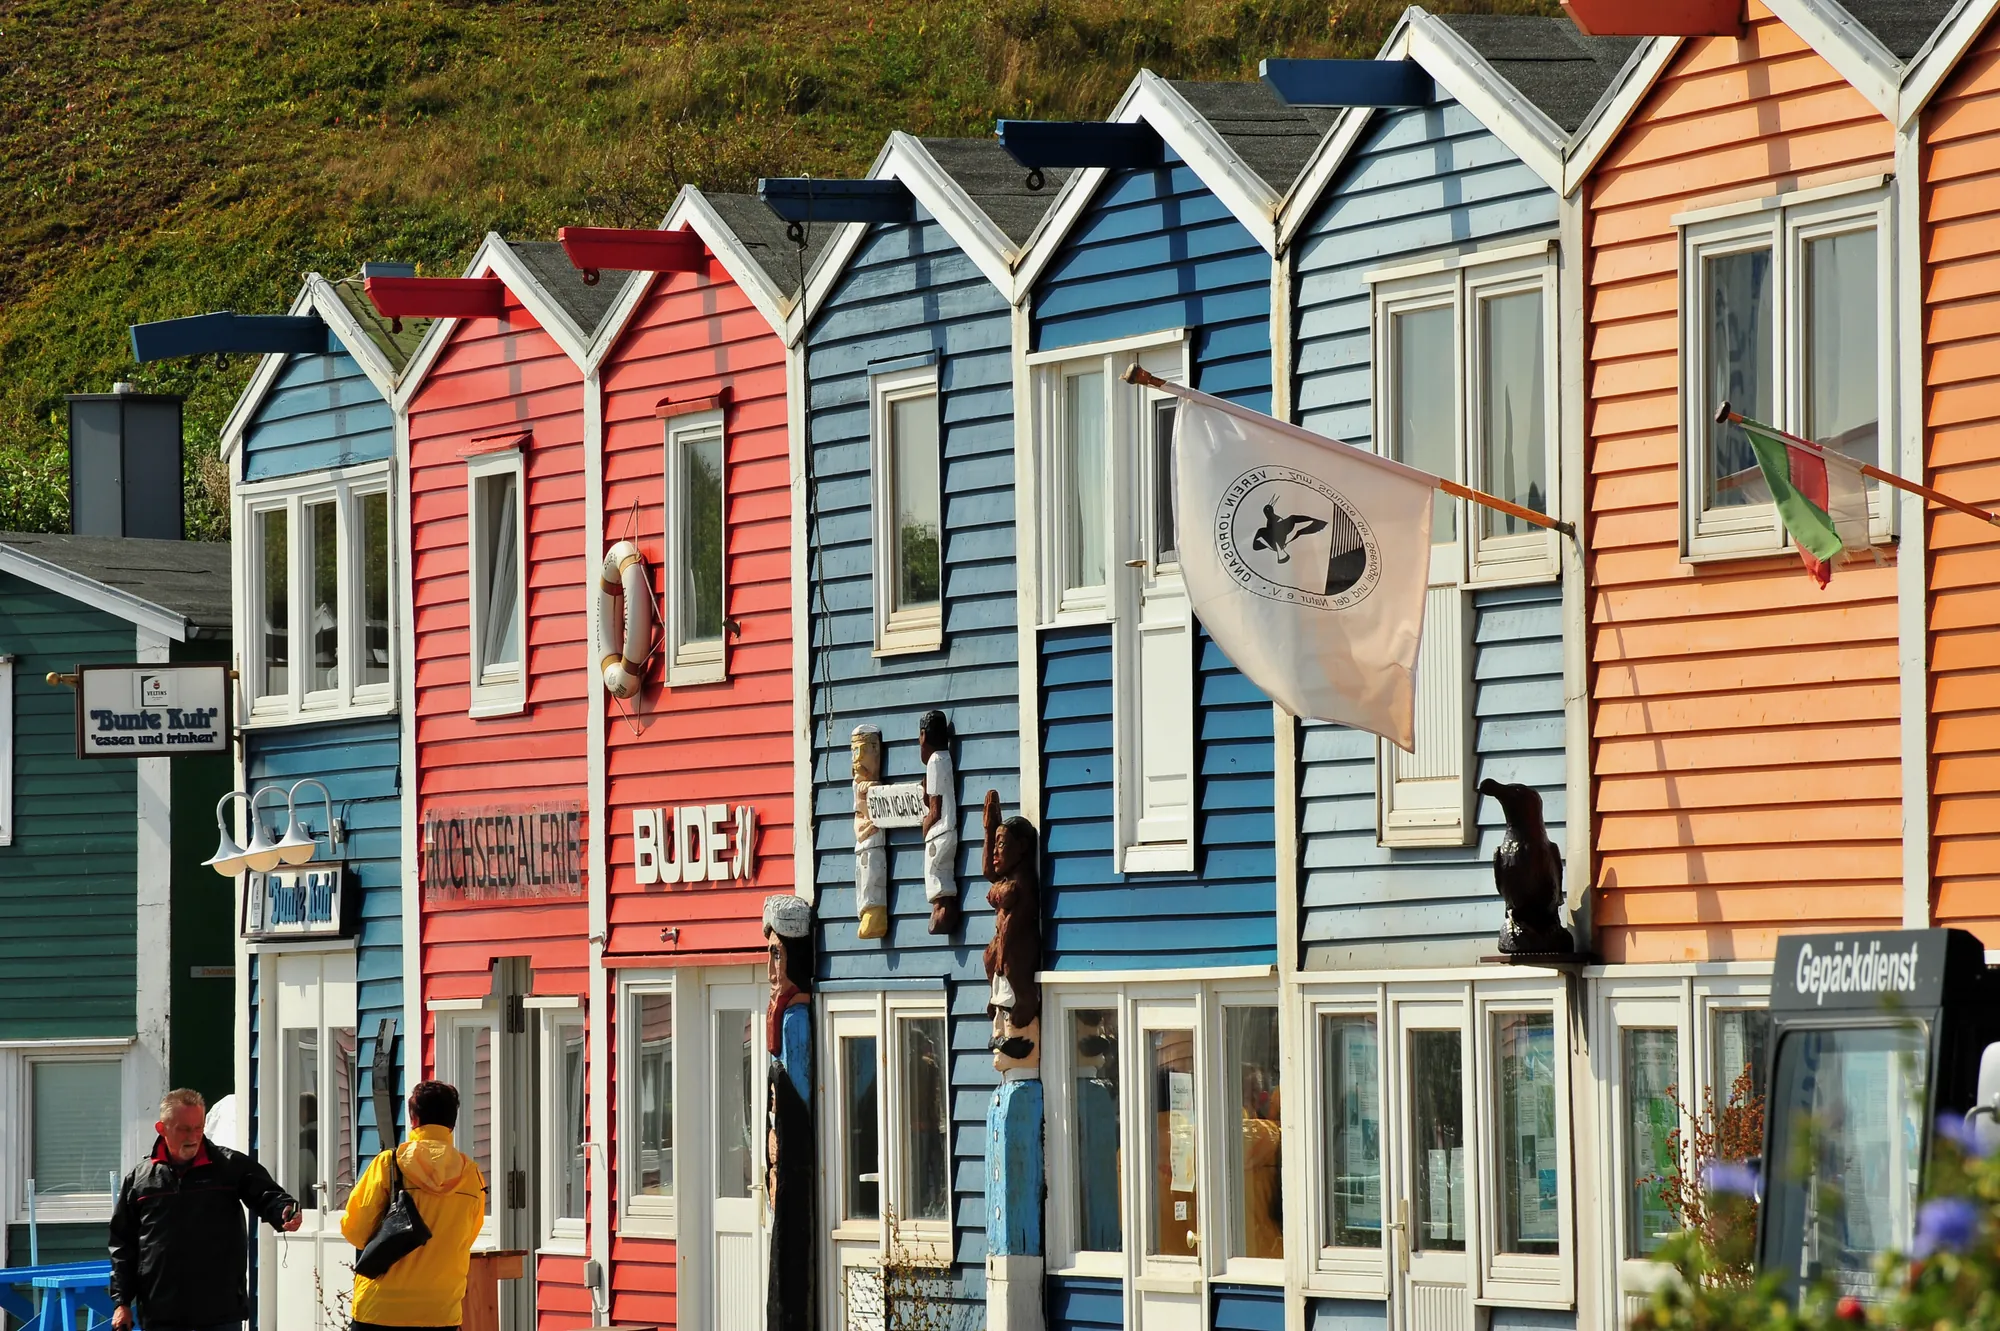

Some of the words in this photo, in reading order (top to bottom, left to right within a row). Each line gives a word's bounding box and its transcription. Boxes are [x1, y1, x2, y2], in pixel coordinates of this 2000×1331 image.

[91, 734, 135, 746] "essen
[138, 732, 164, 745] und
[166, 731, 218, 745] trinken"
[425, 811, 578, 890] HOCHSEEGALERIE
[633, 804, 732, 884] BUDE
[1796, 940, 1919, 1006] Gepäckdienst
